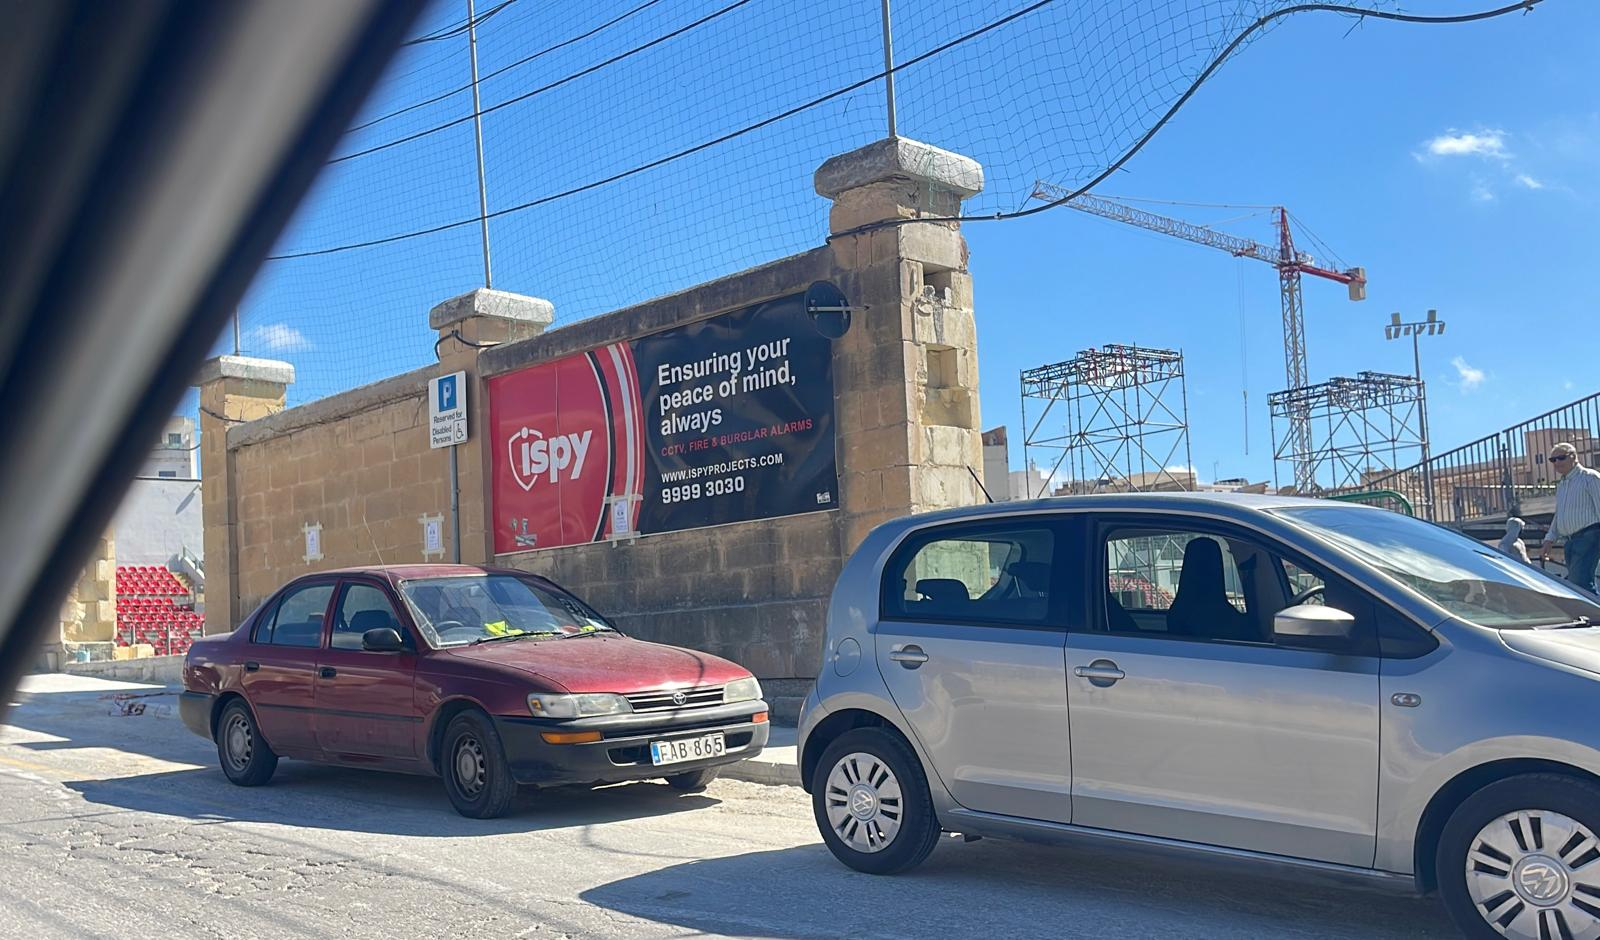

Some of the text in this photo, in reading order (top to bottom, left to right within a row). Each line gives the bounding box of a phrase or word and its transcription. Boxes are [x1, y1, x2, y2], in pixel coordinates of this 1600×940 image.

[658, 337, 791, 386] Ensuring your
[443, 381, 451, 407] P
[659, 360, 796, 416] peace of mind,
[432, 425, 452, 436] Disabled
[434, 413, 455, 424] Reserved
[661, 408, 722, 436] always
[432, 436, 452, 445] Persons
[661, 418, 813, 457] CCTV, FIRE & BURGLAR ALARMS
[521, 426, 593, 484] ispy
[661, 453, 783, 483] WWW.ISPYPROJECTS.COM
[662, 476, 745, 504] 9999 3030
[660, 737, 723, 761] FAB 865
